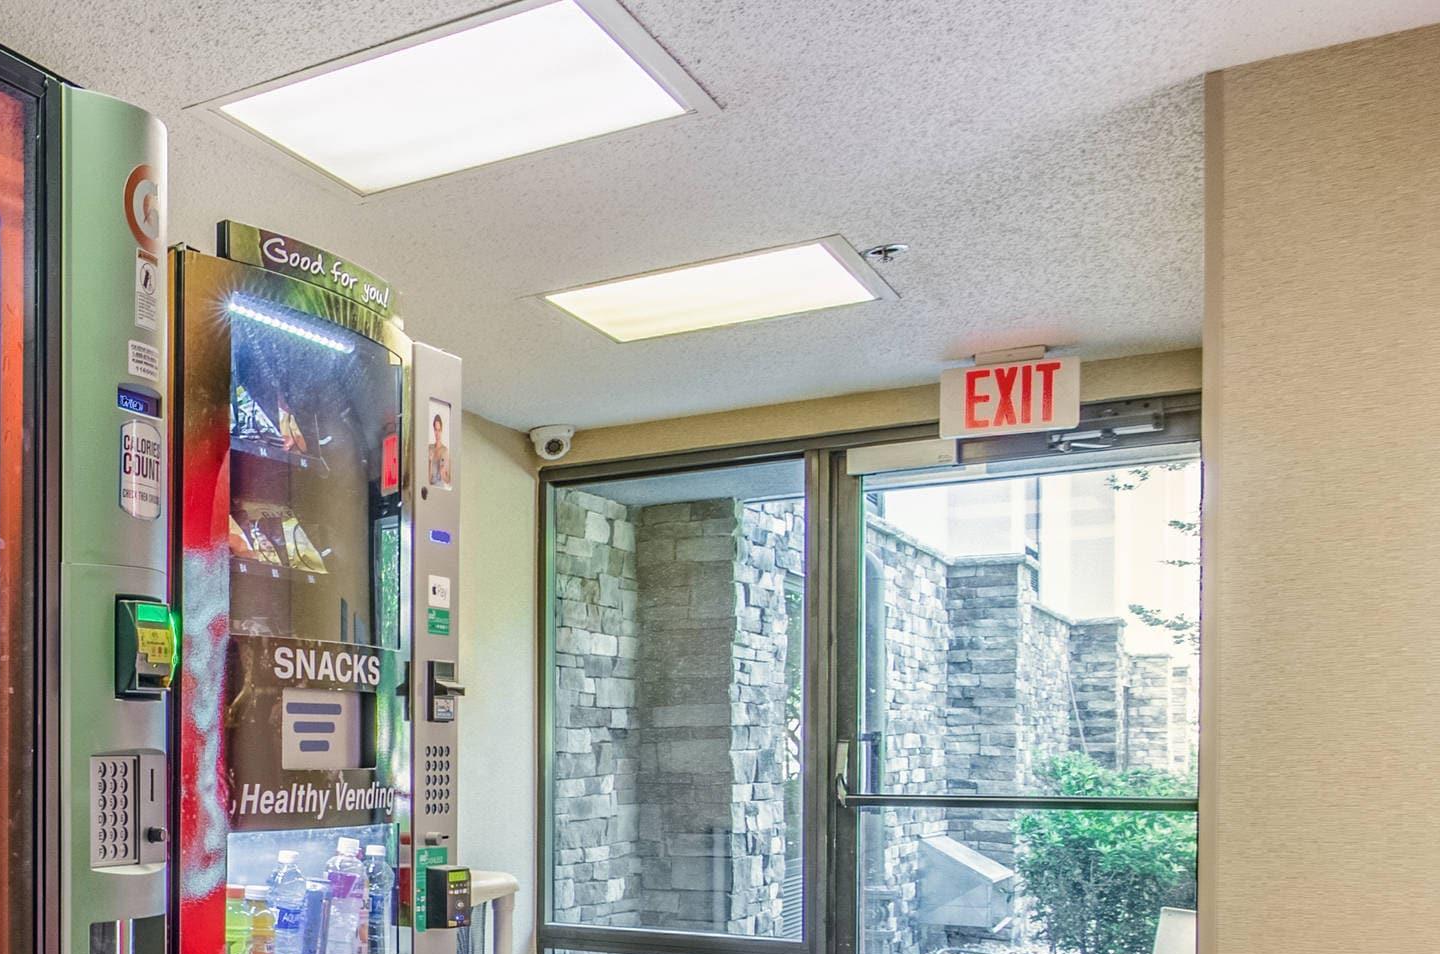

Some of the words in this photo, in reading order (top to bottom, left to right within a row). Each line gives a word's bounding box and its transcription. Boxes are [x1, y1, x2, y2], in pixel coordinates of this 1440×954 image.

[263, 238, 325, 276] Good
[331, 261, 358, 289] for
[362, 287, 389, 309] you!
[964, 360, 1061, 429] EXIT
[274, 646, 380, 686] SNACKS
[240, 782, 330, 820] Healthy
[336, 782, 395, 816] Vending
